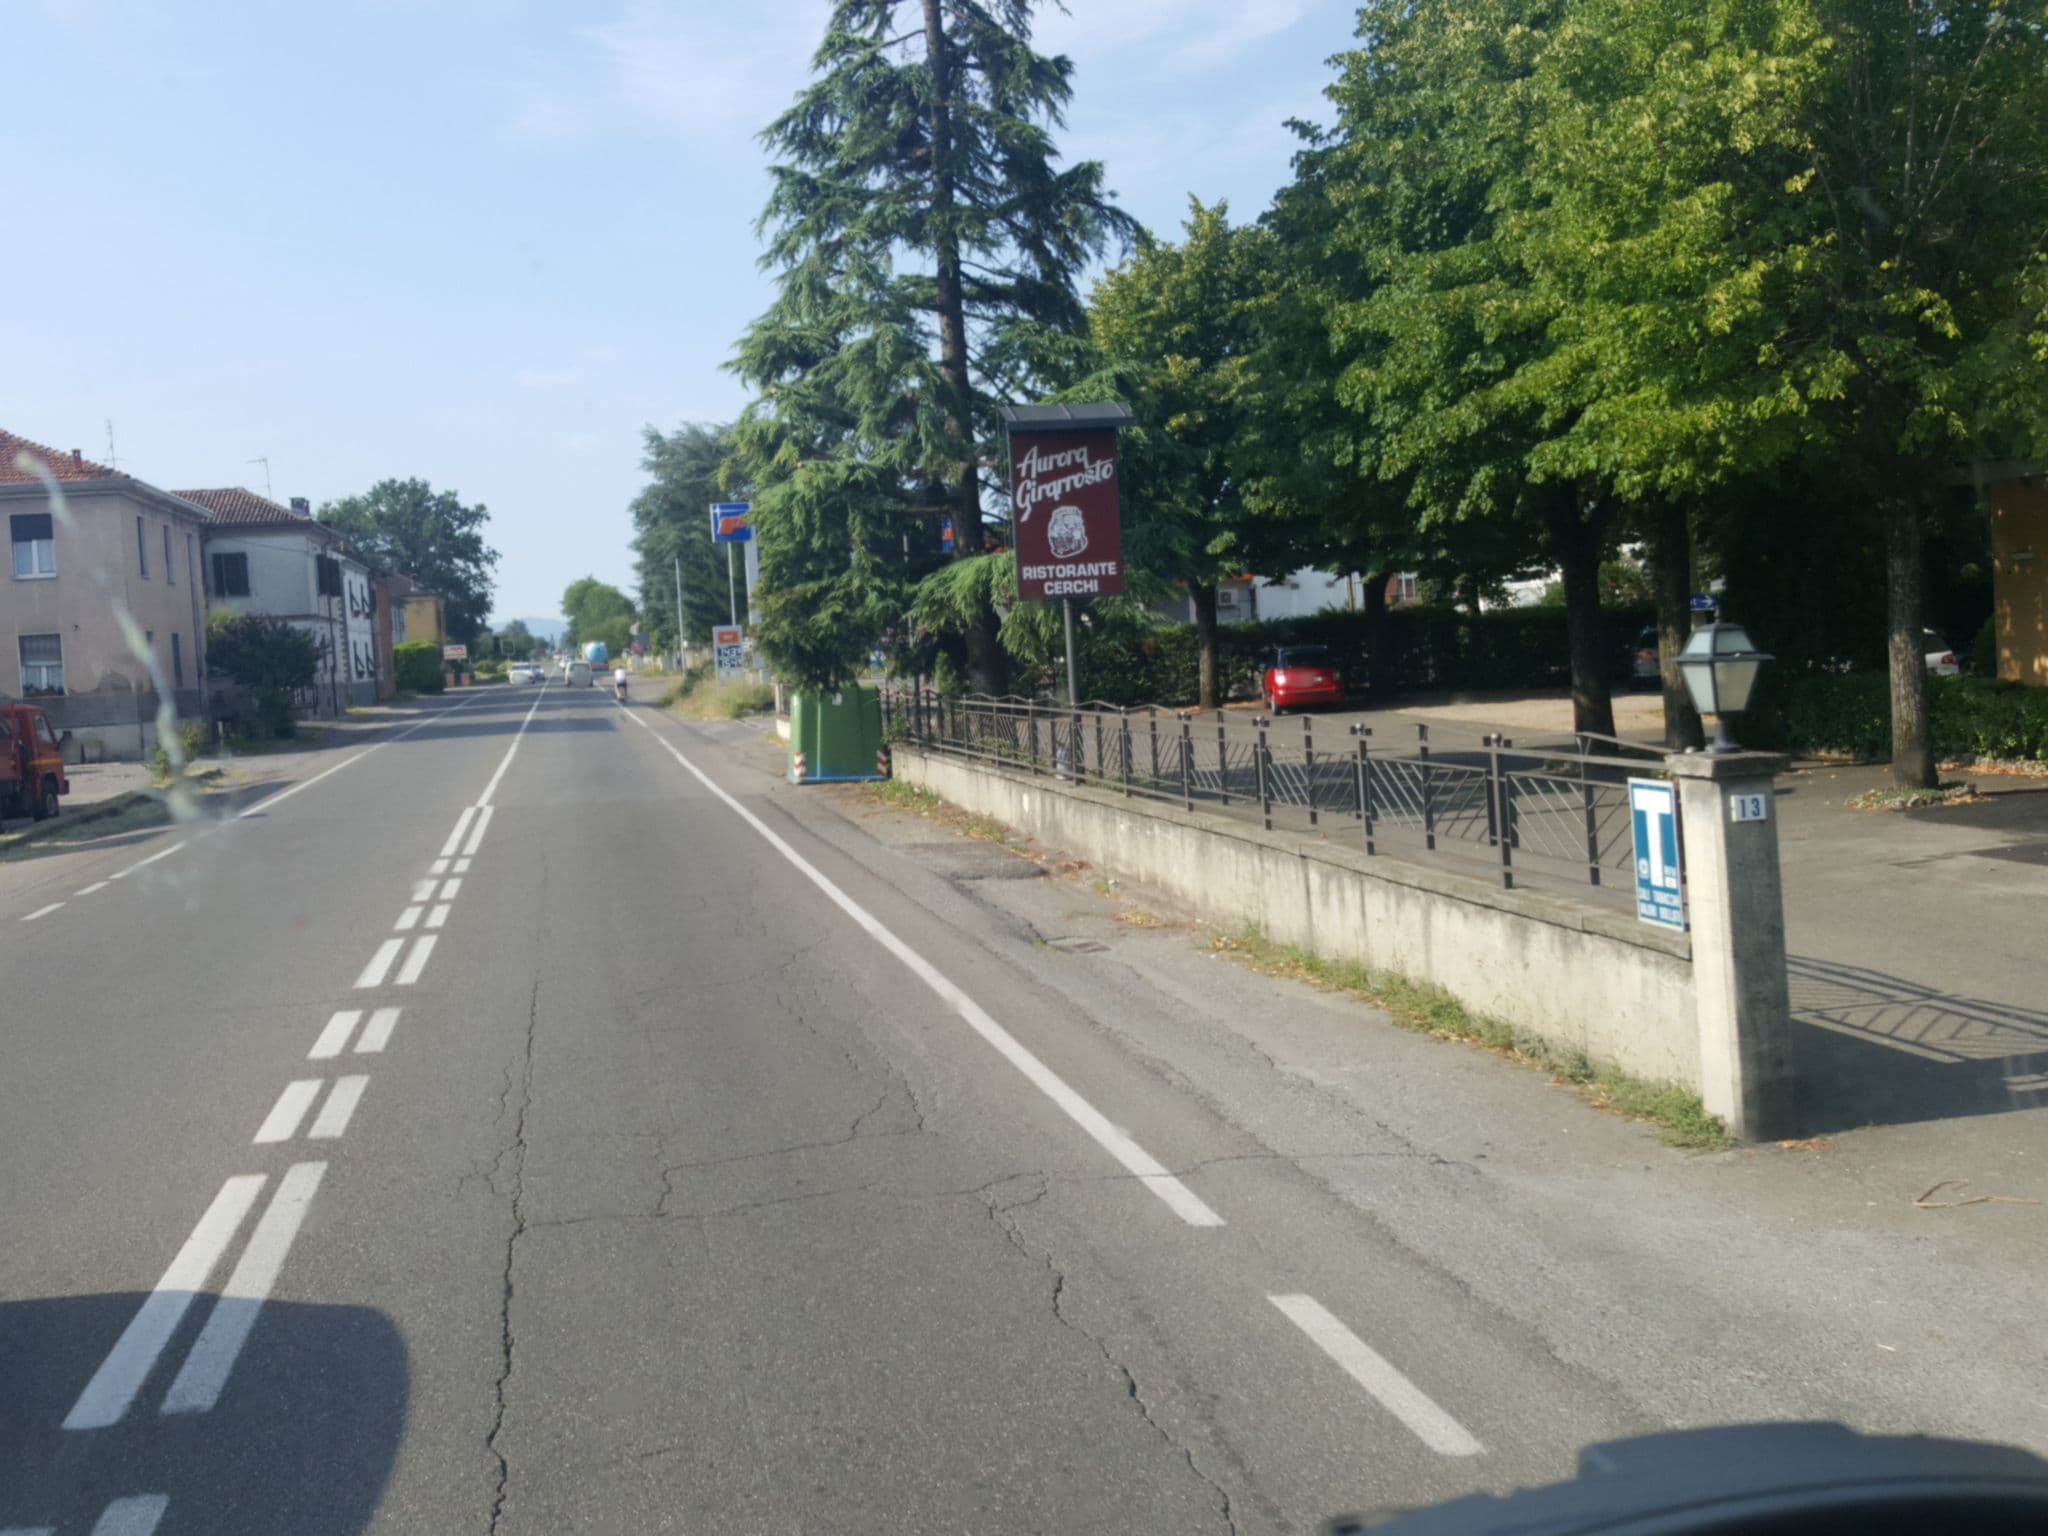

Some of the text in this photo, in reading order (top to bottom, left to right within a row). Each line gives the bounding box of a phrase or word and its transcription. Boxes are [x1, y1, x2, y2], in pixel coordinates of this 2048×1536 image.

[1016, 445, 1090, 479] Aurora
[1016, 458, 1114, 523] Girarrosto
[1022, 562, 1118, 580] RISTORANTE
[1043, 580, 1099, 596] CERCHI
[1739, 797, 1761, 818] 13
